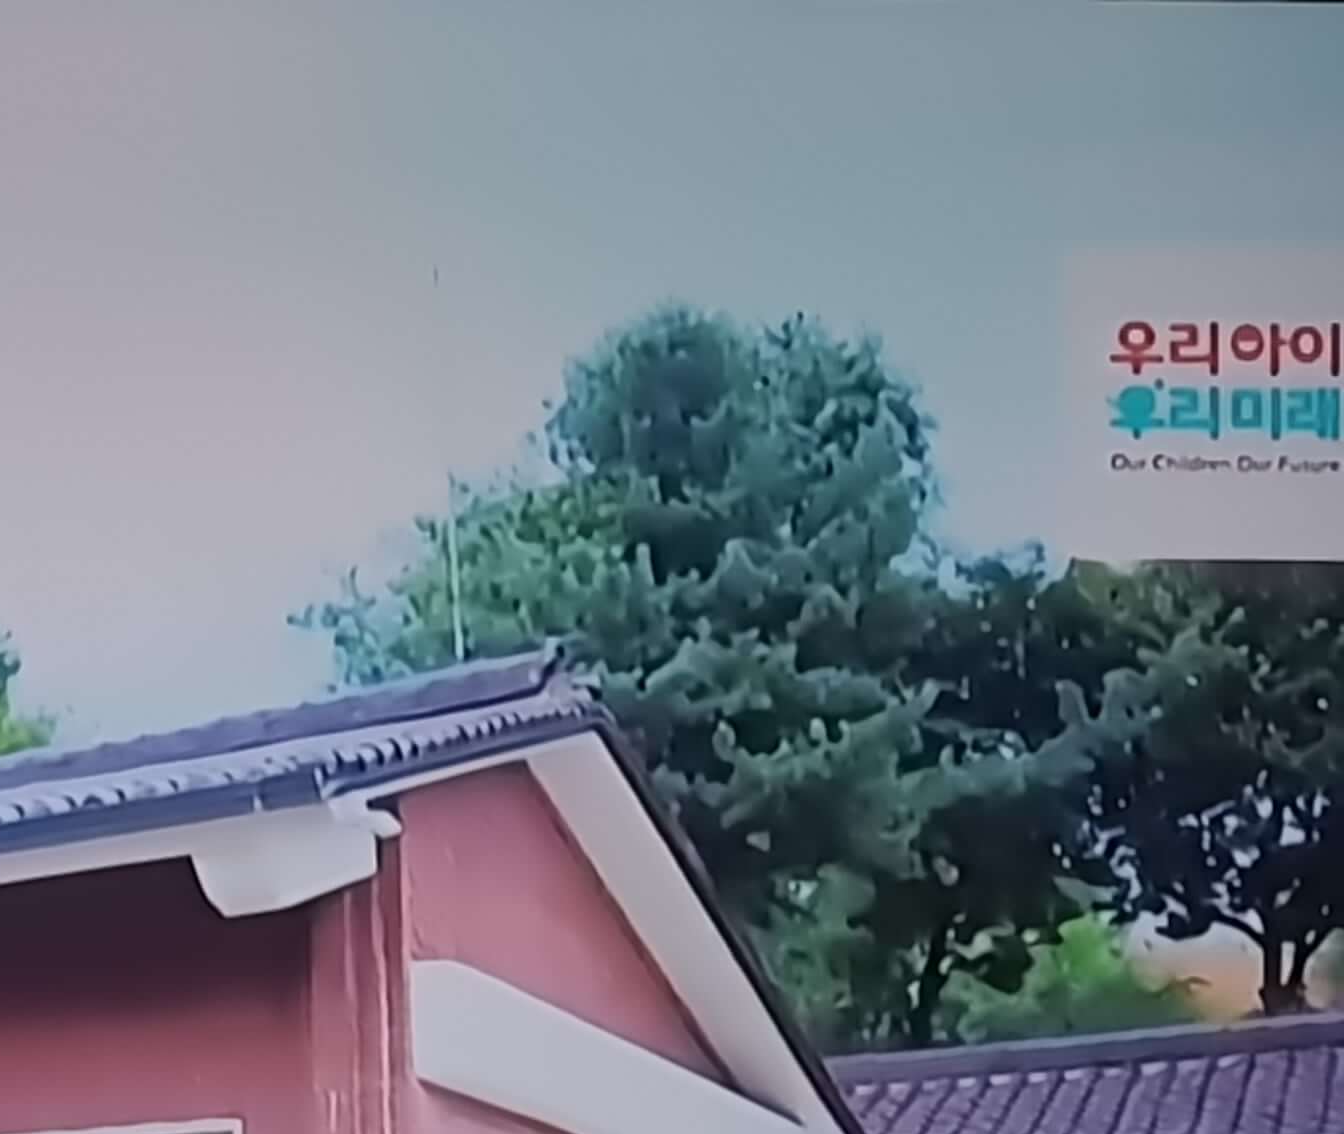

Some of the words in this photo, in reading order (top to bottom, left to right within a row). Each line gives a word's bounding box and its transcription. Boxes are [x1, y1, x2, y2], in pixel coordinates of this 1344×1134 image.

[1109, 321, 1341, 376] 우리아이
[1107, 379, 1341, 440] 우리미래
[1110, 453, 1146, 471] Our
[1152, 454, 1230, 471] Children
[1237, 455, 1272, 472] Our
[1277, 456, 1340, 472] Future
